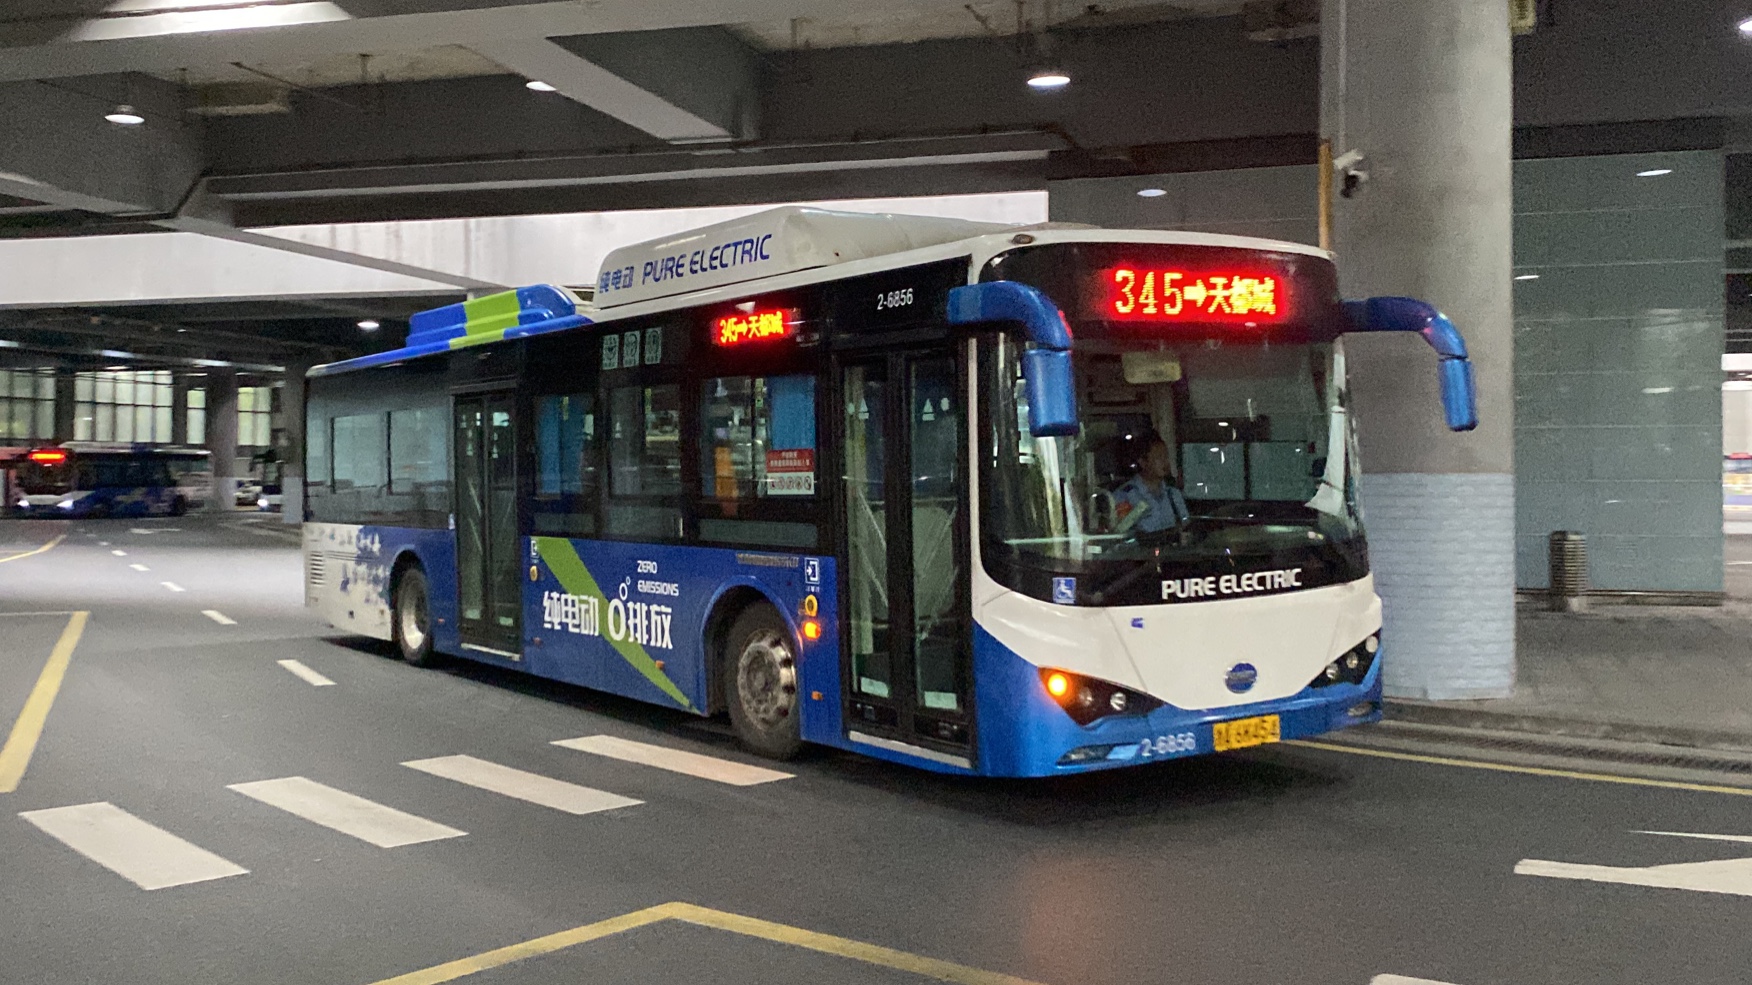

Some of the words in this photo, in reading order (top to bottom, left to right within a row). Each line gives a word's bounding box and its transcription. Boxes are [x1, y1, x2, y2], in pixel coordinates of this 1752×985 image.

[599, 266, 635, 294] 纯电动
[642, 253, 687, 285] PURE
[690, 233, 773, 275] ELECTRIC
[877, 288, 914, 311] 2-6856
[1115, 269, 1183, 315] 345
[719, 317, 739, 343] 345
[637, 560, 657, 574] ZERO
[637, 580, 680, 597] EMISSIONS
[1161, 576, 1216, 600] PURE
[1219, 568, 1303, 594] ELECTRIC
[542, 590, 600, 637] 纯电动
[1140, 731, 1197, 757] 2-6856
